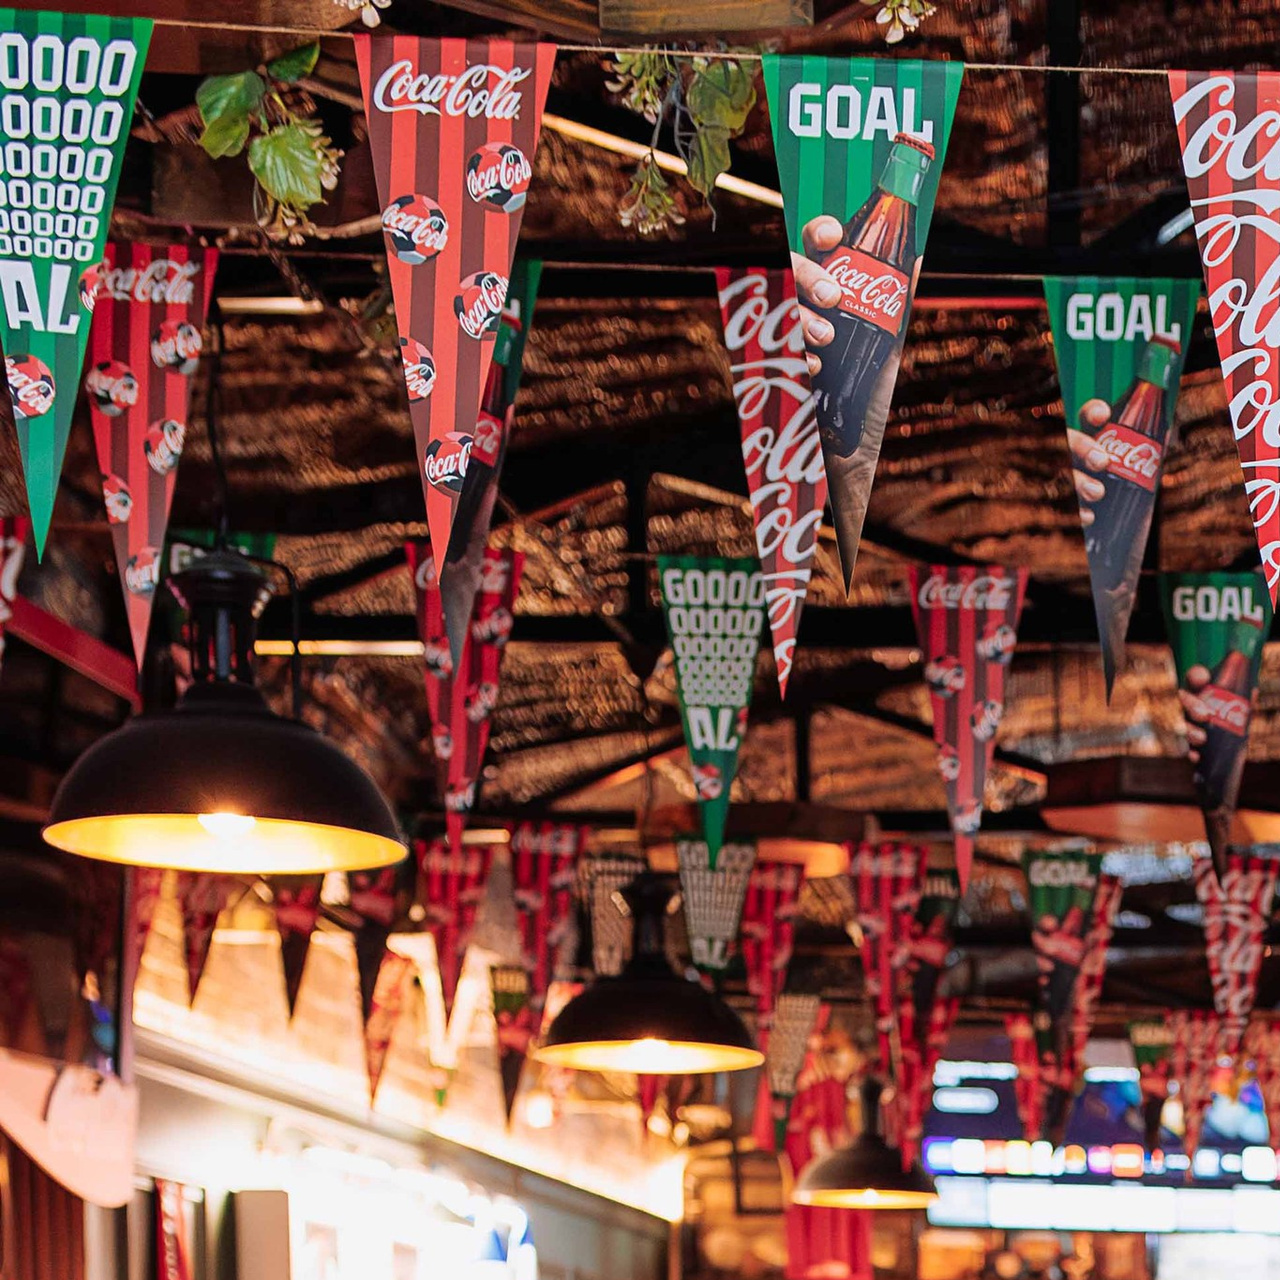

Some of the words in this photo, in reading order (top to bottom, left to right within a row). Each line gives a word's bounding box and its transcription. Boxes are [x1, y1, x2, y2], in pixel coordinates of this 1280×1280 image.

[374, 60, 532, 120] Coca-Cola
[789, 83, 933, 143] GOAL
[0, 260, 80, 334] AL
[823, 256, 908, 318] Coca-Cola
[844, 299, 878, 319] CLASSIC
[1067, 293, 1181, 342] GOAL
[1173, 586, 1264, 621] GOAL
[686, 706, 739, 751] AL
